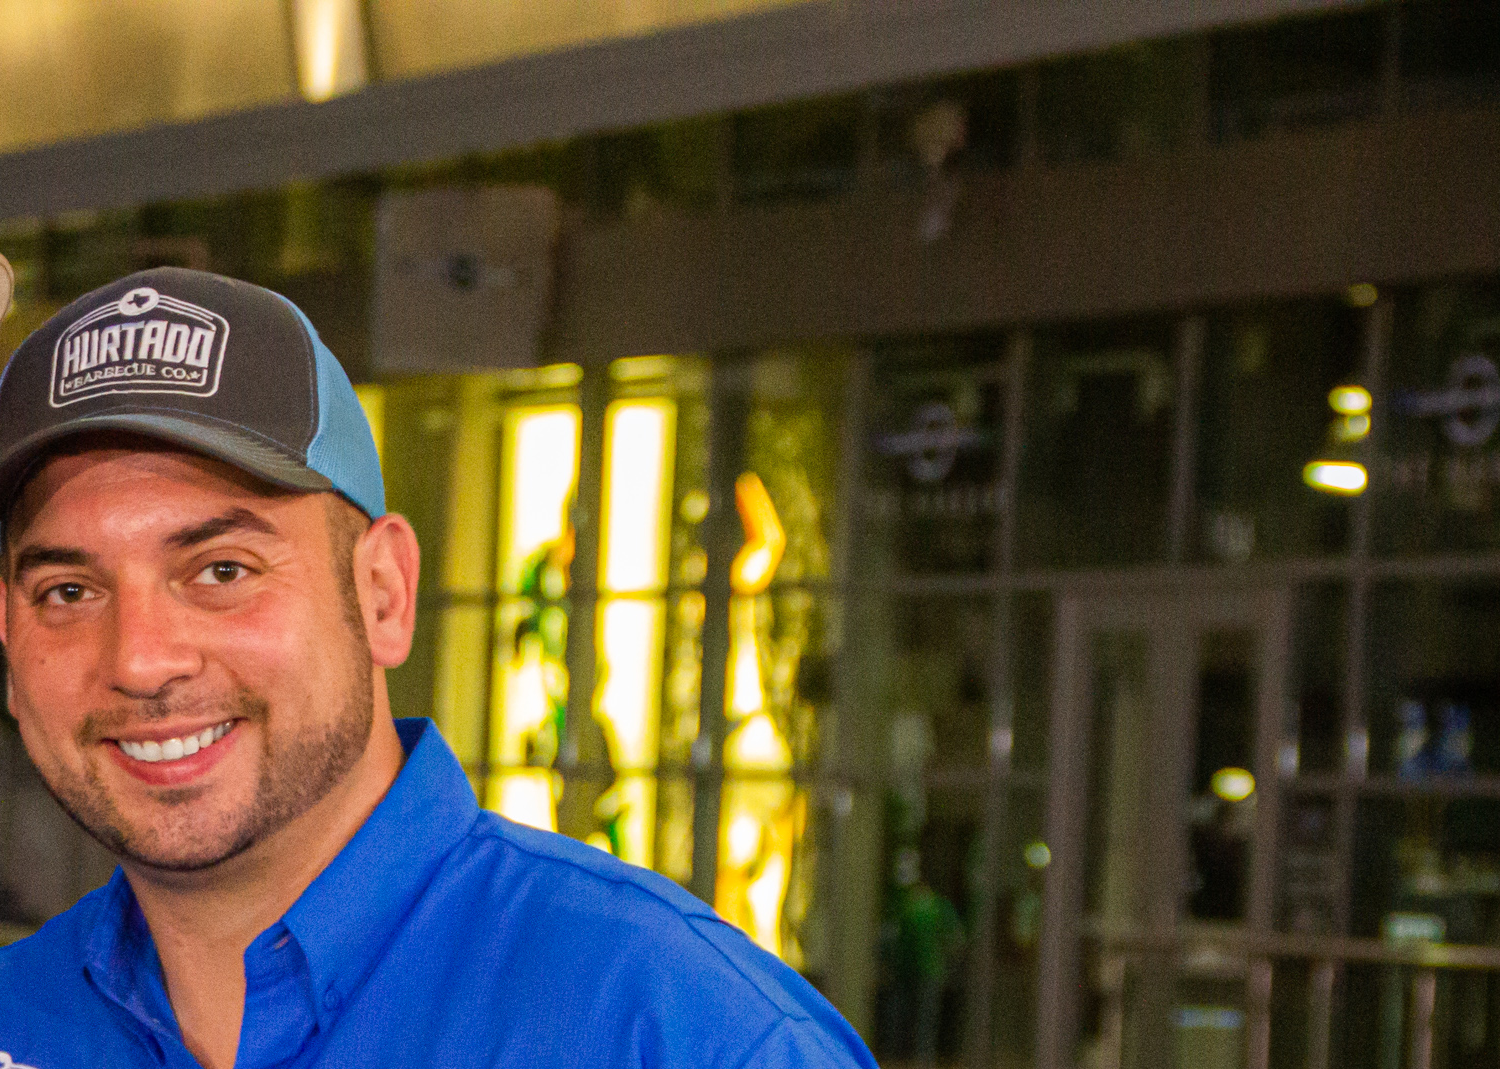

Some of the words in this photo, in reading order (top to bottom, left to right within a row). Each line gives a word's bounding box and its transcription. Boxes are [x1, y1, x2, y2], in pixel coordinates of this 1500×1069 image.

[62, 320, 215, 377] HURTADO
[74, 363, 156, 388] BARBECUE
[161, 366, 190, 380] CO.
